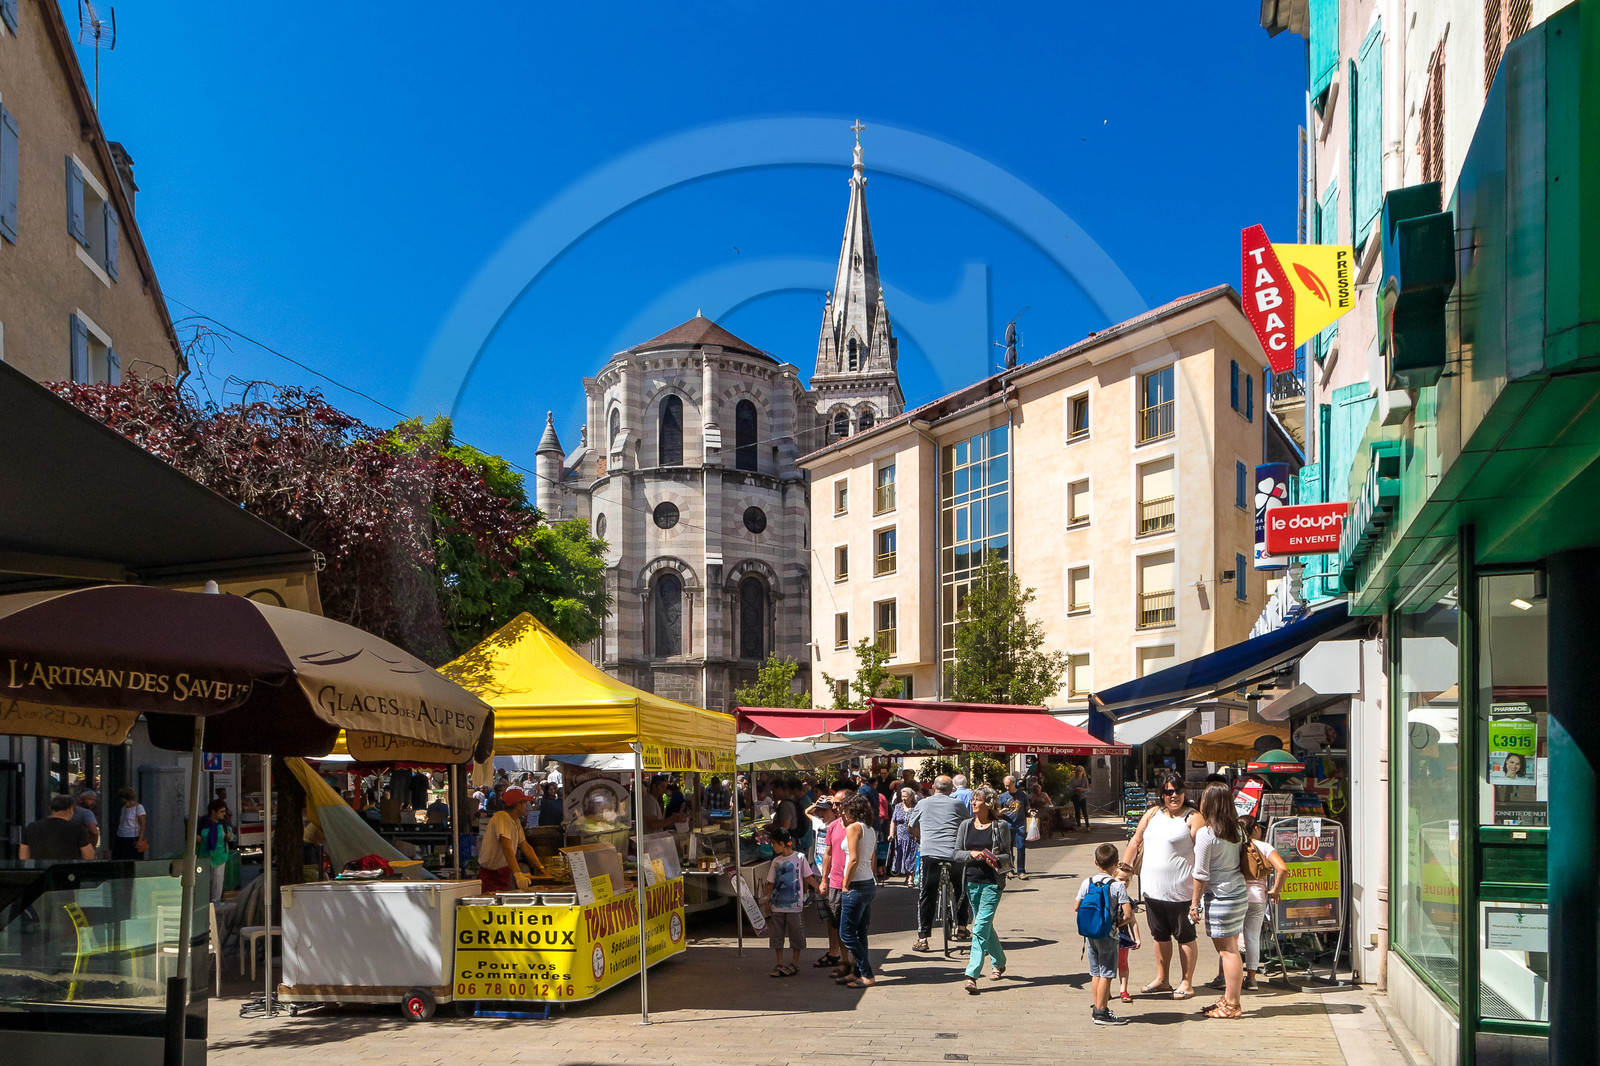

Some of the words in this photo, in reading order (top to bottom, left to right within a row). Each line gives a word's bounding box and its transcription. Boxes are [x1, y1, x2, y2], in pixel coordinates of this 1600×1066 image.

[1337, 251, 1350, 308] PRESSE
[1249, 247, 1288, 351] TABAC
[1271, 516, 1287, 530] le
[1288, 512, 1348, 530] dauph
[1289, 537, 1303, 545] EN
[1304, 534, 1337, 543] VENTE
[128, 671, 170, 693] DES
[317, 685, 399, 716] GLACES
[399, 708, 416, 719] DES
[417, 700, 475, 731] ALPES
[1500, 735, 1531, 748] 3915
[1279, 880, 1339, 893] LECTRONIQUE
[646, 880, 684, 920] RAVIOLES
[482, 911, 553, 925] Julien
[459, 930, 575, 945] GRANOUX
[478, 961, 518, 970] Pour
[528, 963, 556, 971] vos
[461, 970, 572, 981] Commandes
[457, 983, 476, 996] 06
[485, 983, 502, 996] 78
[509, 983, 526, 996] 00
[533, 984, 549, 997] 12
[556, 984, 575, 997] 16
